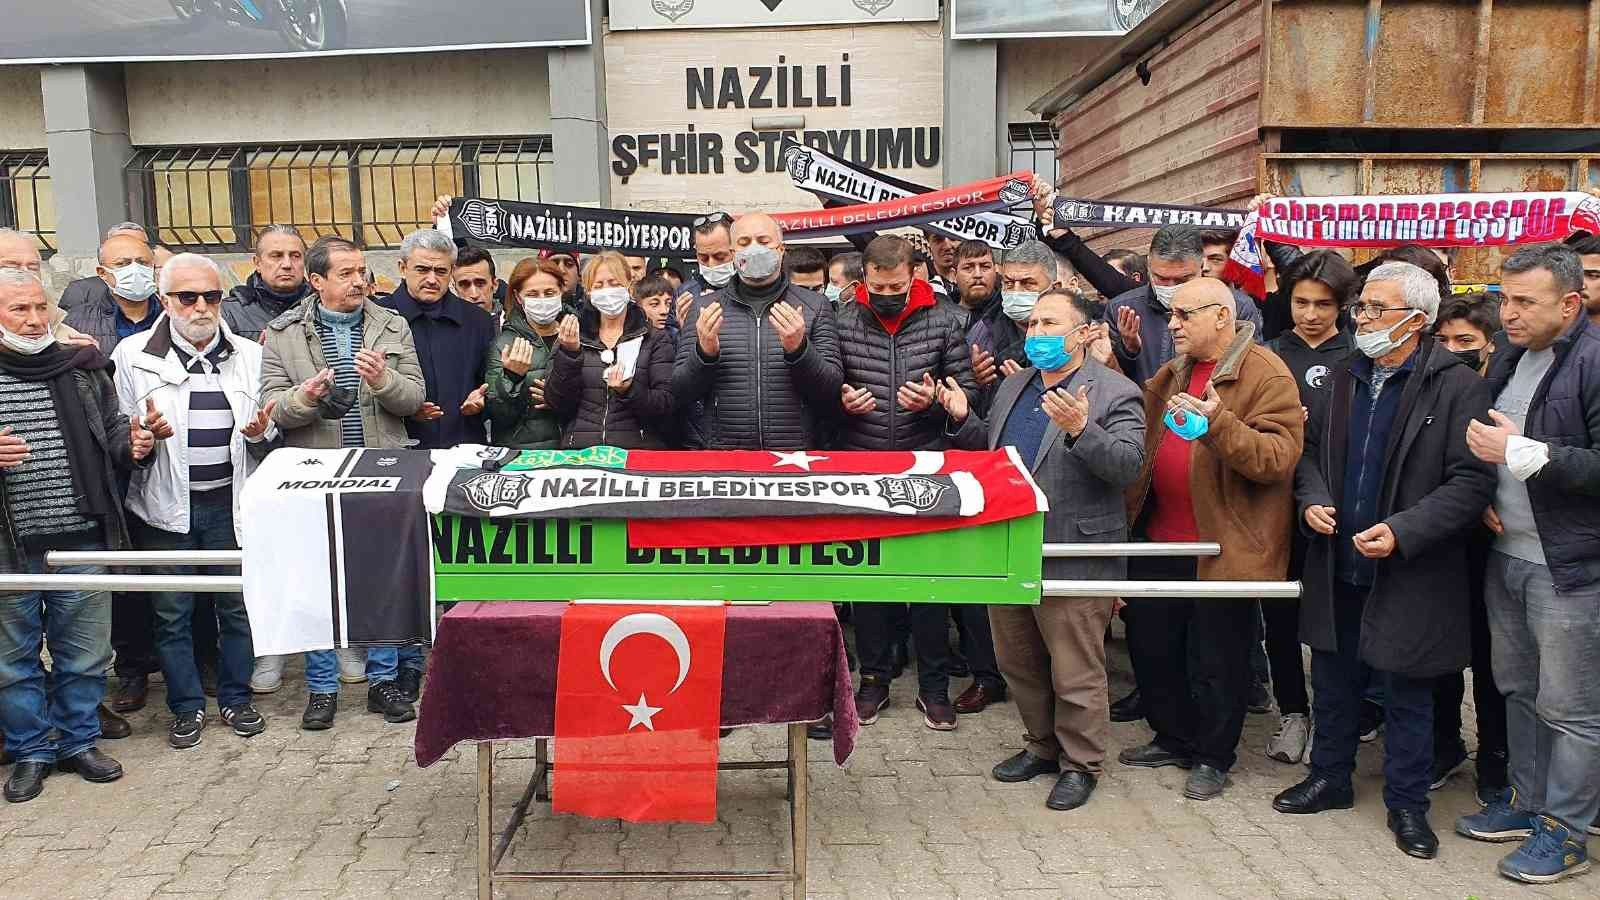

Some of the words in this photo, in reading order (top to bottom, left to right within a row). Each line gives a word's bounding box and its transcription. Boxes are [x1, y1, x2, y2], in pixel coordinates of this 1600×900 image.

[686, 53, 852, 110] NAZİLLİ
[815, 166, 877, 203] NAZİLLİ
[509, 209, 574, 243] NAZİLLİ
[576, 215, 691, 251] BELEDİYESPOR
[540, 472, 650, 499] NAZİLLİ
[659, 477, 870, 499] BELEDİYESPOR
